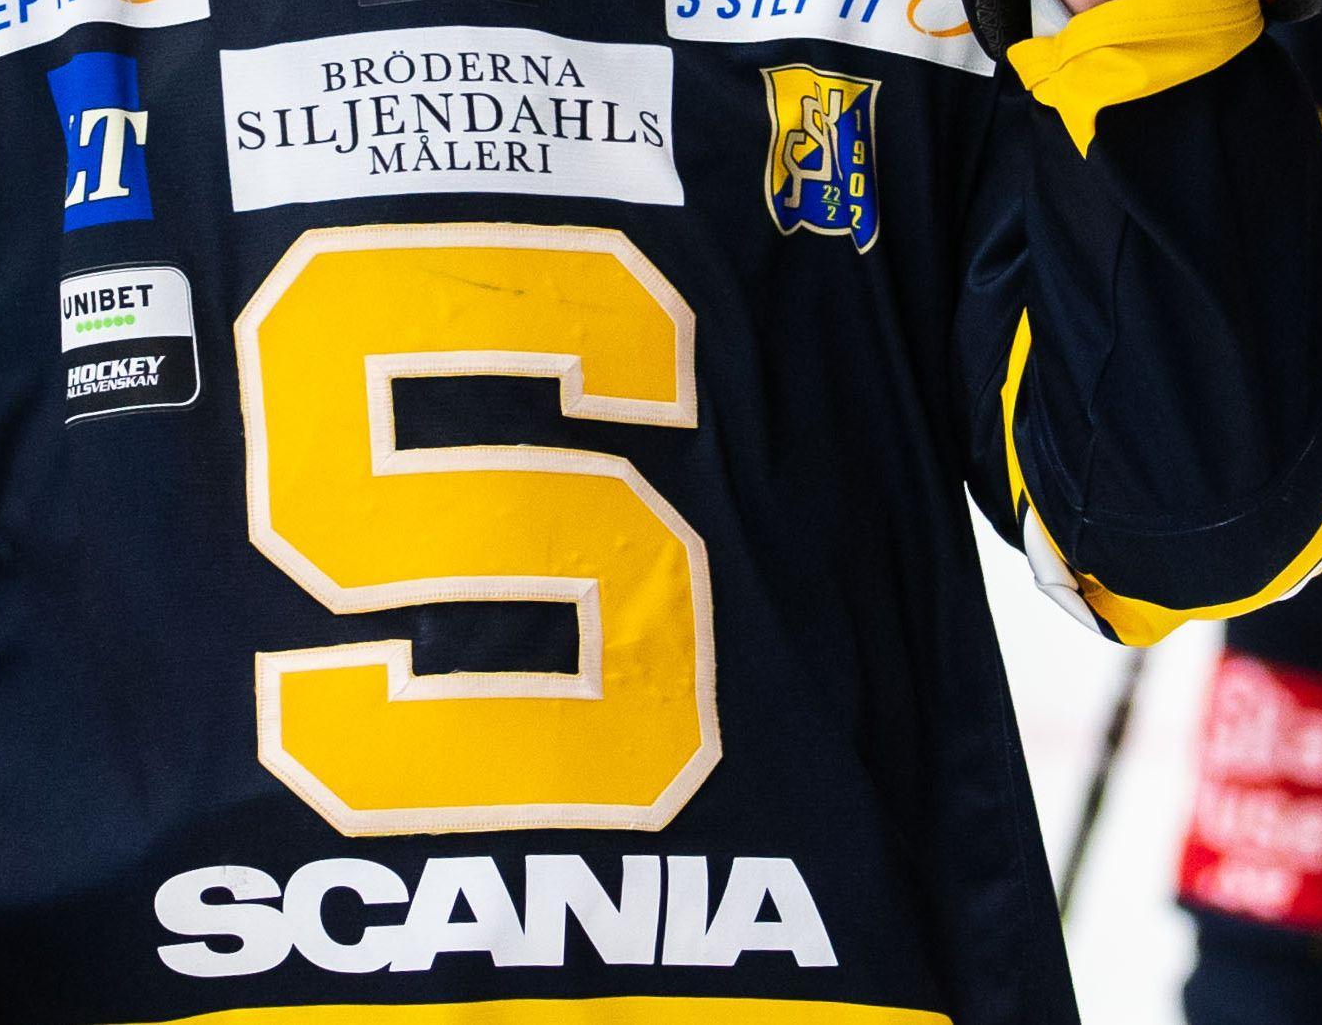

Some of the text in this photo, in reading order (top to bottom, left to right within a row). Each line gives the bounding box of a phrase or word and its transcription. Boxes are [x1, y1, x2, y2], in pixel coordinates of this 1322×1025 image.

[320, 49, 585, 94] BRÖDERNA
[236, 92, 666, 155] SILJENDAHLS
[368, 134, 554, 177] MÅLERI
[848, 108, 867, 230] 1902
[63, 284, 154, 320] UNIBET
[67, 355, 166, 388] HOCKEY
[233, 221, 724, 838] S
[153, 853, 838, 978] SCANIA
